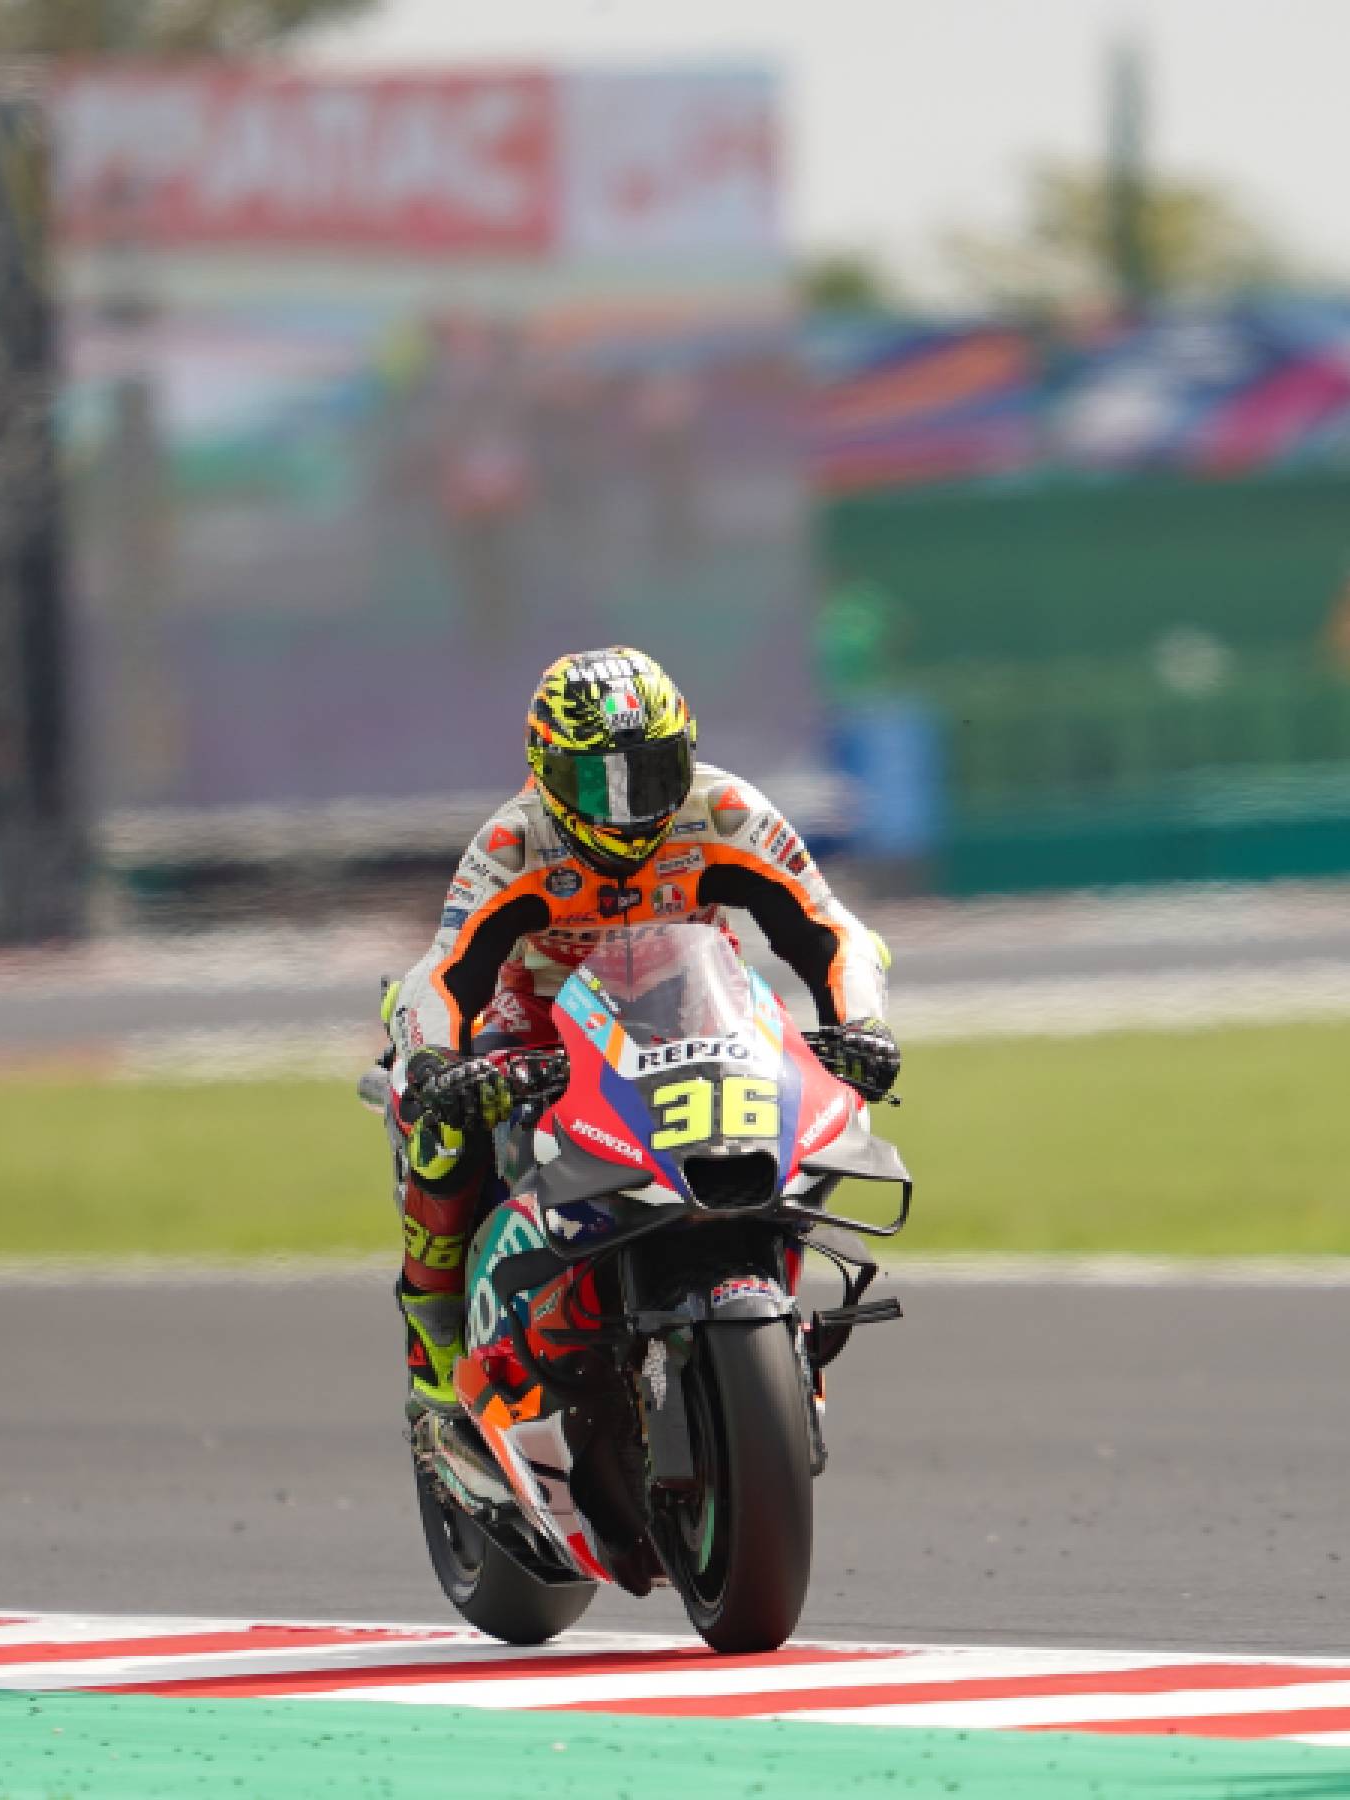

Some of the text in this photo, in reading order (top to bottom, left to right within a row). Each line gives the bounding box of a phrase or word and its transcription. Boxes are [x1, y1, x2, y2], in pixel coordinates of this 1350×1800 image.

[570, 1118, 644, 1165] HONDA
[651, 1077, 779, 1150] 36
[404, 1214, 466, 1270] 36
